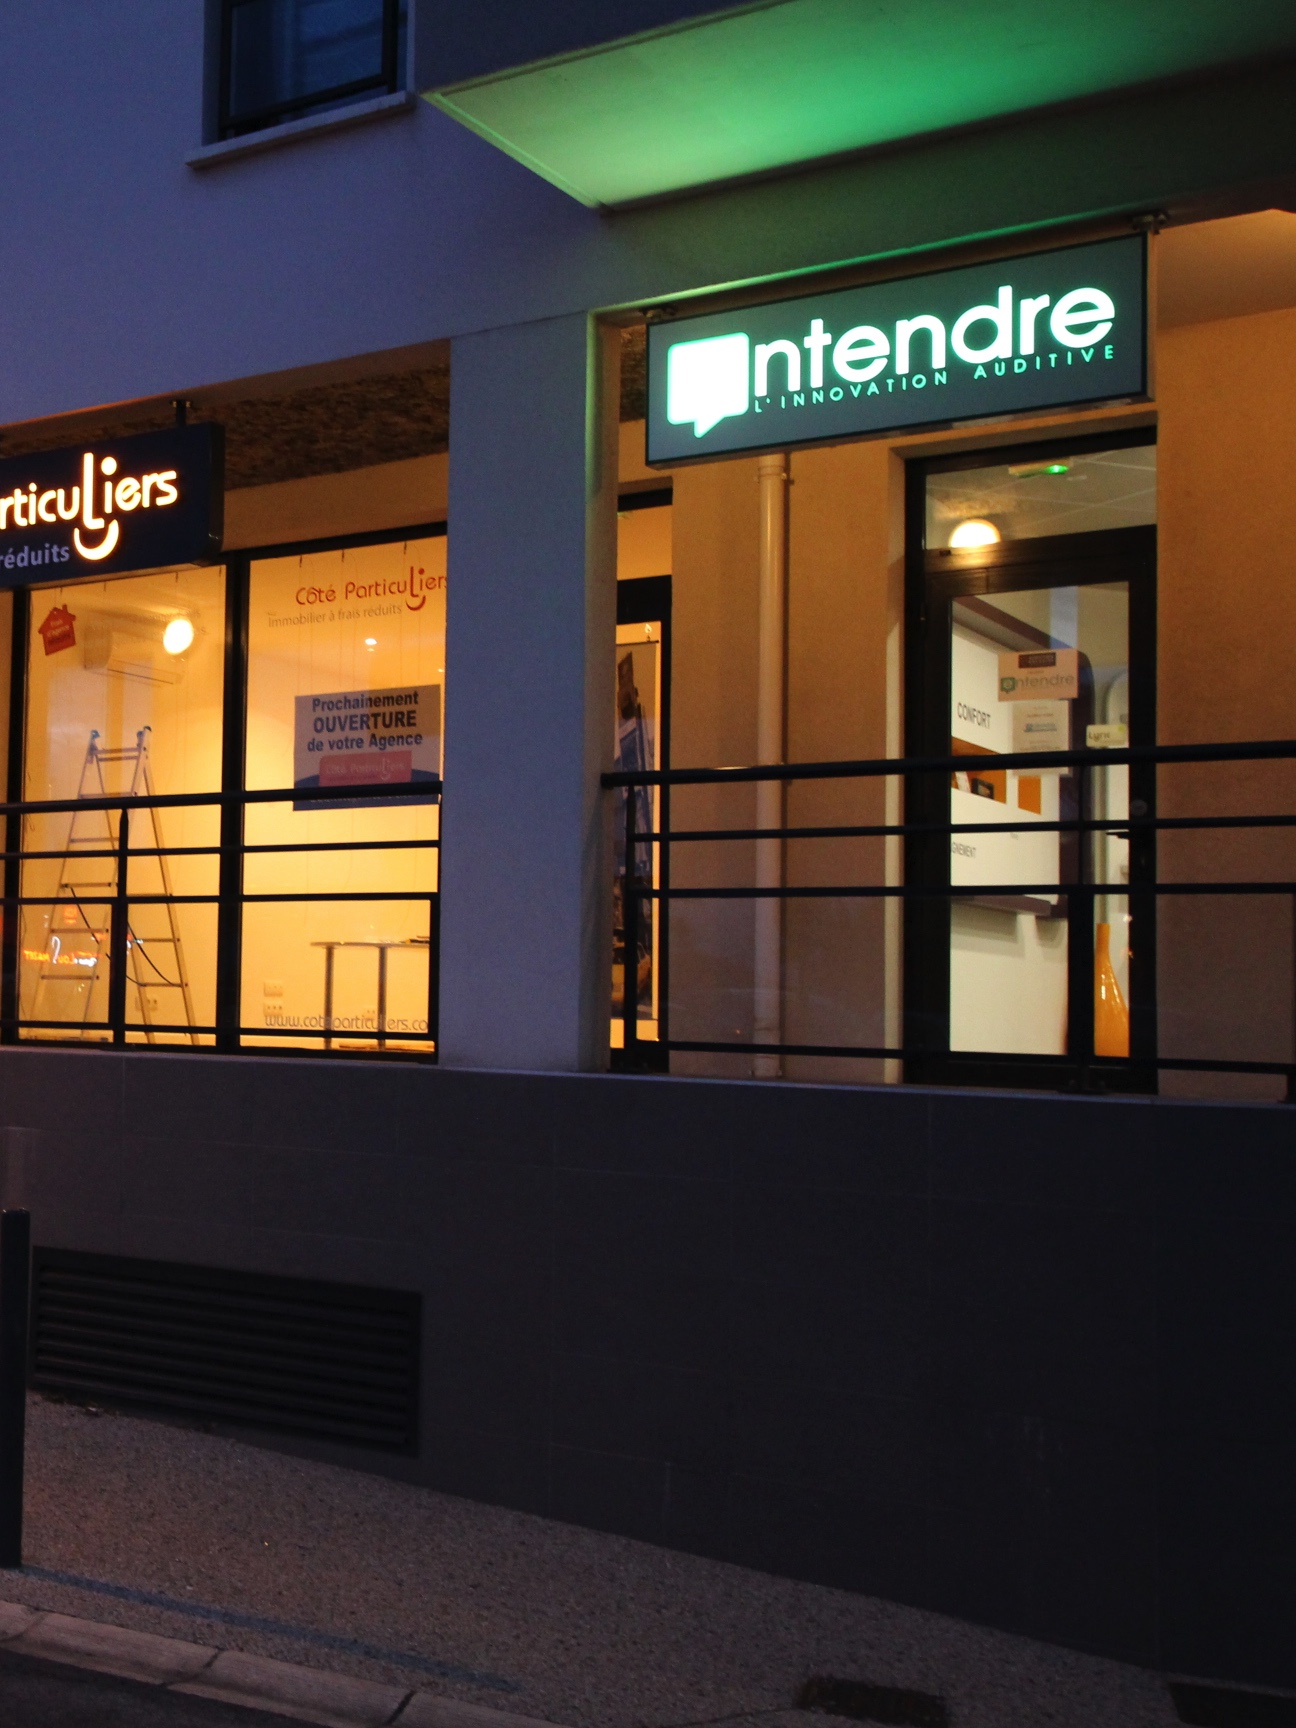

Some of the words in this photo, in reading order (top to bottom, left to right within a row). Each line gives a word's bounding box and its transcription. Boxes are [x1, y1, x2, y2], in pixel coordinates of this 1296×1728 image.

[679, 284, 1116, 412] ntendre
[754, 370, 947, 413] L'INNOVATION
[973, 344, 1115, 380] AUDITIVE
[296, 584, 337, 605] Côté
[268, 613, 326, 628] Immobilier
[329, 611, 335, 622] à
[338, 608, 361, 620] frais
[363, 604, 402, 618] réduits
[312, 691, 419, 712] Prochainement
[314, 710, 417, 733] OUVERTURE
[957, 702, 991, 729] CONFORT
[307, 738, 323, 752] de
[328, 737, 364, 750] votre
[368, 733, 423, 751] Agence
